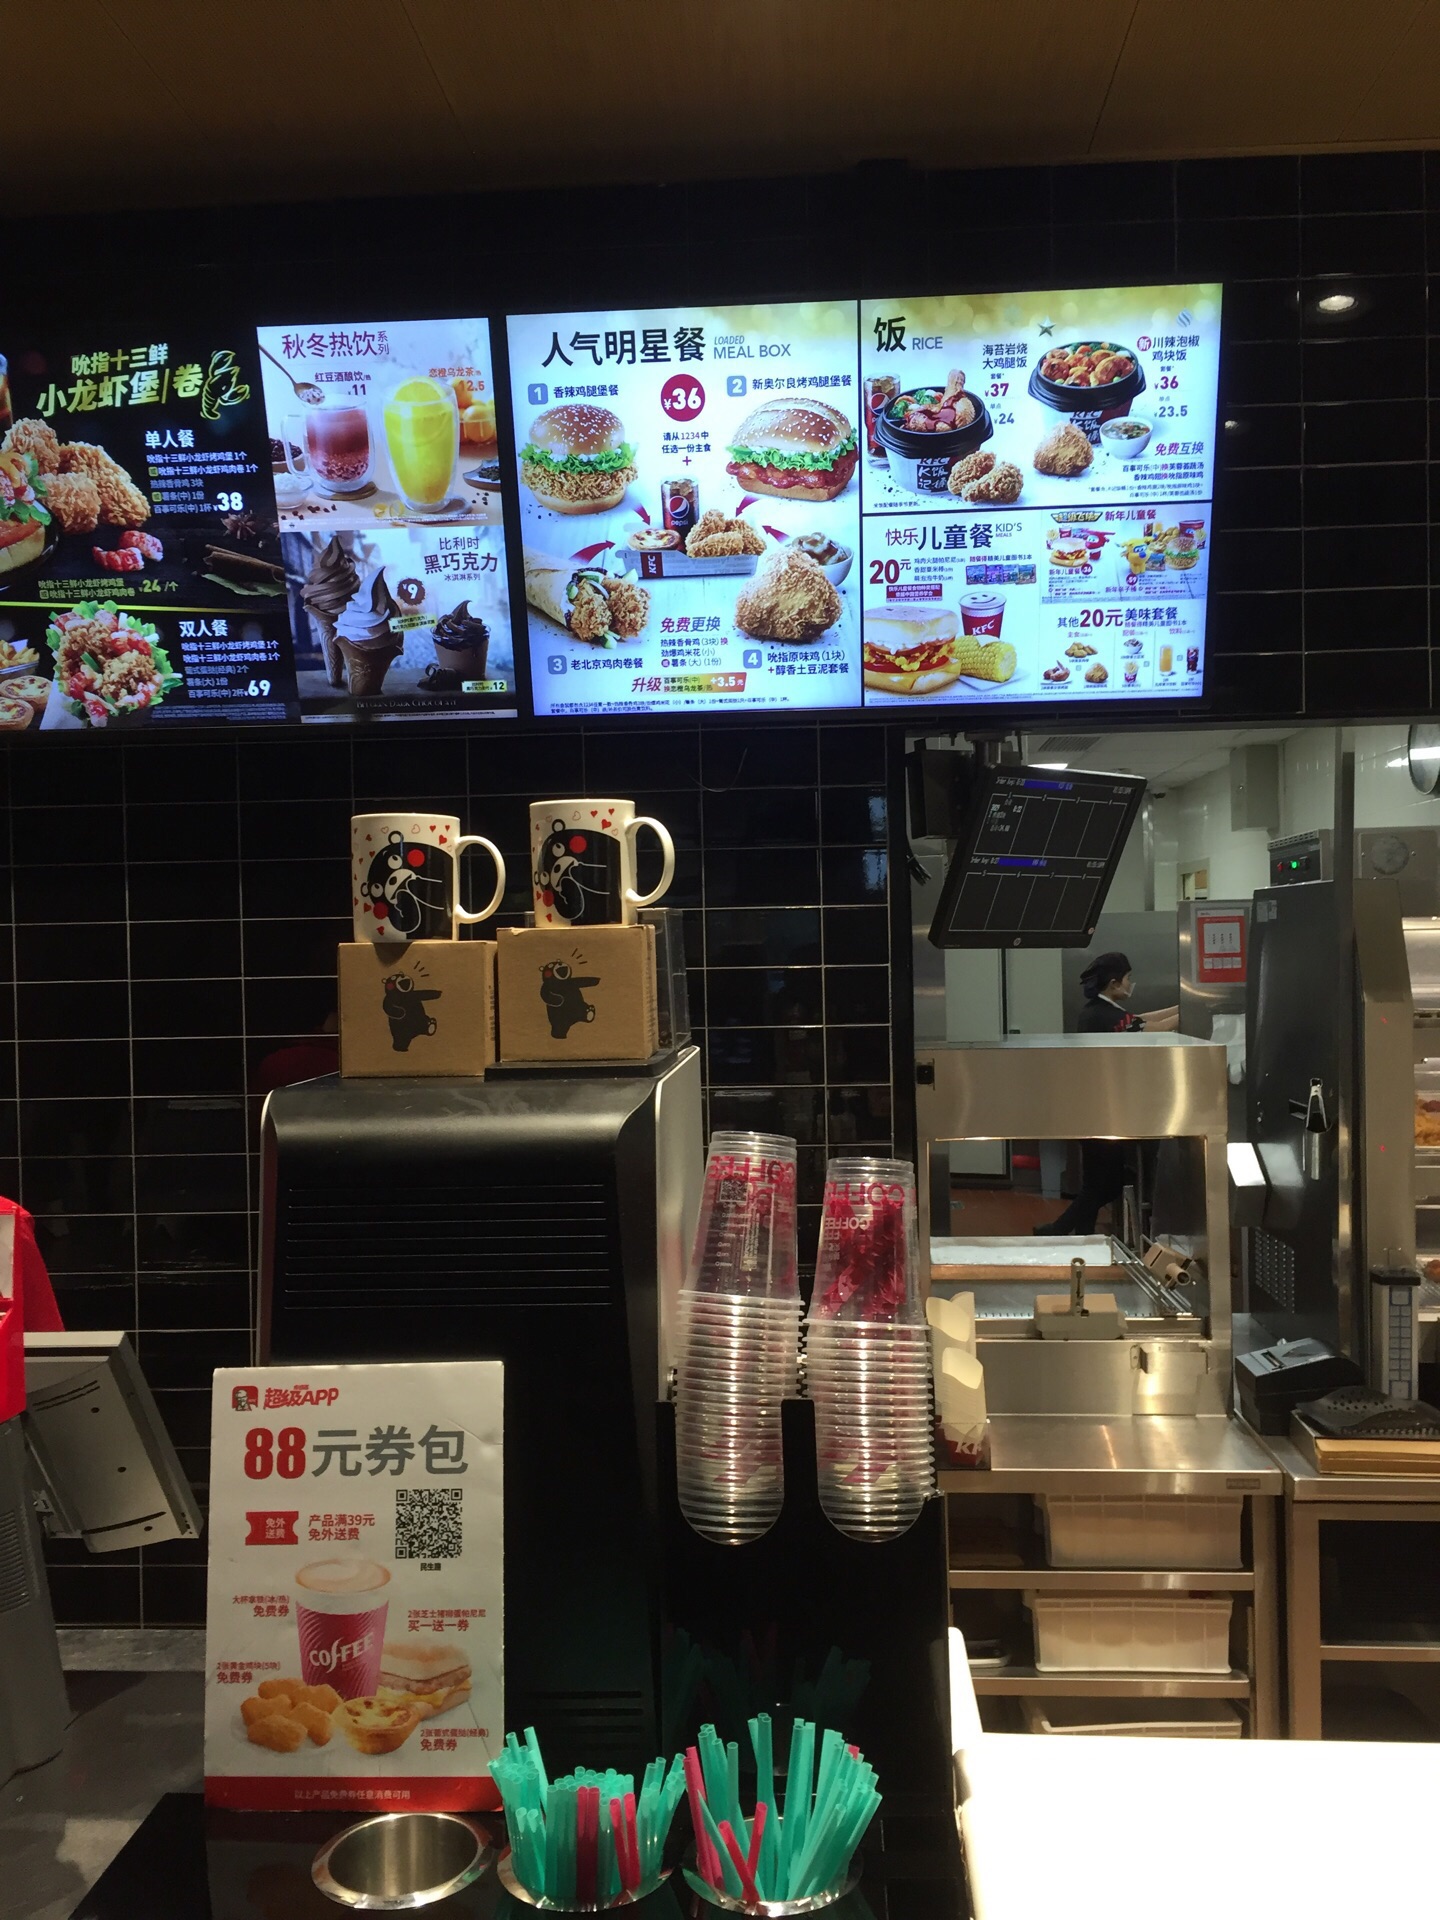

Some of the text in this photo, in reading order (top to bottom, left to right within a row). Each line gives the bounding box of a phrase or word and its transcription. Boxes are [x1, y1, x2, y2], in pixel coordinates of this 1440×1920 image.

[714, 335, 745, 345] LOADED
[874, 316, 943, 353] 饭 RICE
[1152, 335, 1200, 348] 川辣泡椒
[281, 330, 378, 359] 秋冬热饮
[542, 326, 706, 367] 人气明星餐
[982, 343, 1028, 356] 海苔岩烧
[713, 344, 791, 360] MEAL BOX
[1152, 349, 1187, 362] 鸡块饭
[71, 343, 169, 376] 吮指十三鲜
[982, 356, 1028, 370] 大鸡腿饭
[732, 379, 743, 394] 2
[752, 375, 852, 390] 新奥尔良烤鸡腿堡餐
[1154, 376, 1179, 390] ¥36
[533, 388, 542, 401] 1
[553, 384, 619, 399] 香辣鸡腿堡餐
[984, 383, 1009, 398] ¥37
[664, 387, 701, 411] ¥36
[994, 412, 1015, 425] ¥24
[1154, 405, 1188, 418] ¥23.5
[145, 429, 195, 449] 单人餐
[663, 431, 709, 441] 请从1234中
[662, 443, 711, 454] 任选一份主食
[1155, 441, 1204, 456] 免费互换
[1105, 509, 1157, 521] 新年儿童餐
[439, 537, 479, 550] 比利时
[885, 523, 993, 551] 快乐儿童餐
[423, 552, 498, 575] 黑巧克力
[648, 555, 657, 574] KFC
[179, 619, 228, 638] 双人餐
[660, 616, 720, 633] 免费更换
[972, 619, 995, 636] KFC
[747, 653, 759, 666] 4
[767, 650, 846, 663] 吮指原味鸡(1块)
[552, 659, 563, 671] 3
[571, 658, 644, 671] 老北京鸡肉卷餐
[631, 677, 662, 693] 升级
[244, 1424, 469, 1480] 88元券包
[265, 1518, 286, 1528] 免外
[308, 1513, 375, 1527] 产品满39元
[265, 1529, 286, 1539] 送费
[308, 1527, 360, 1541] 免外送费
[253, 1604, 290, 1617] 免费券
[408, 1619, 469, 1632] 买一送一券
[216, 1671, 253, 1684] 免费券
[420, 1738, 457, 1752] 免费券
